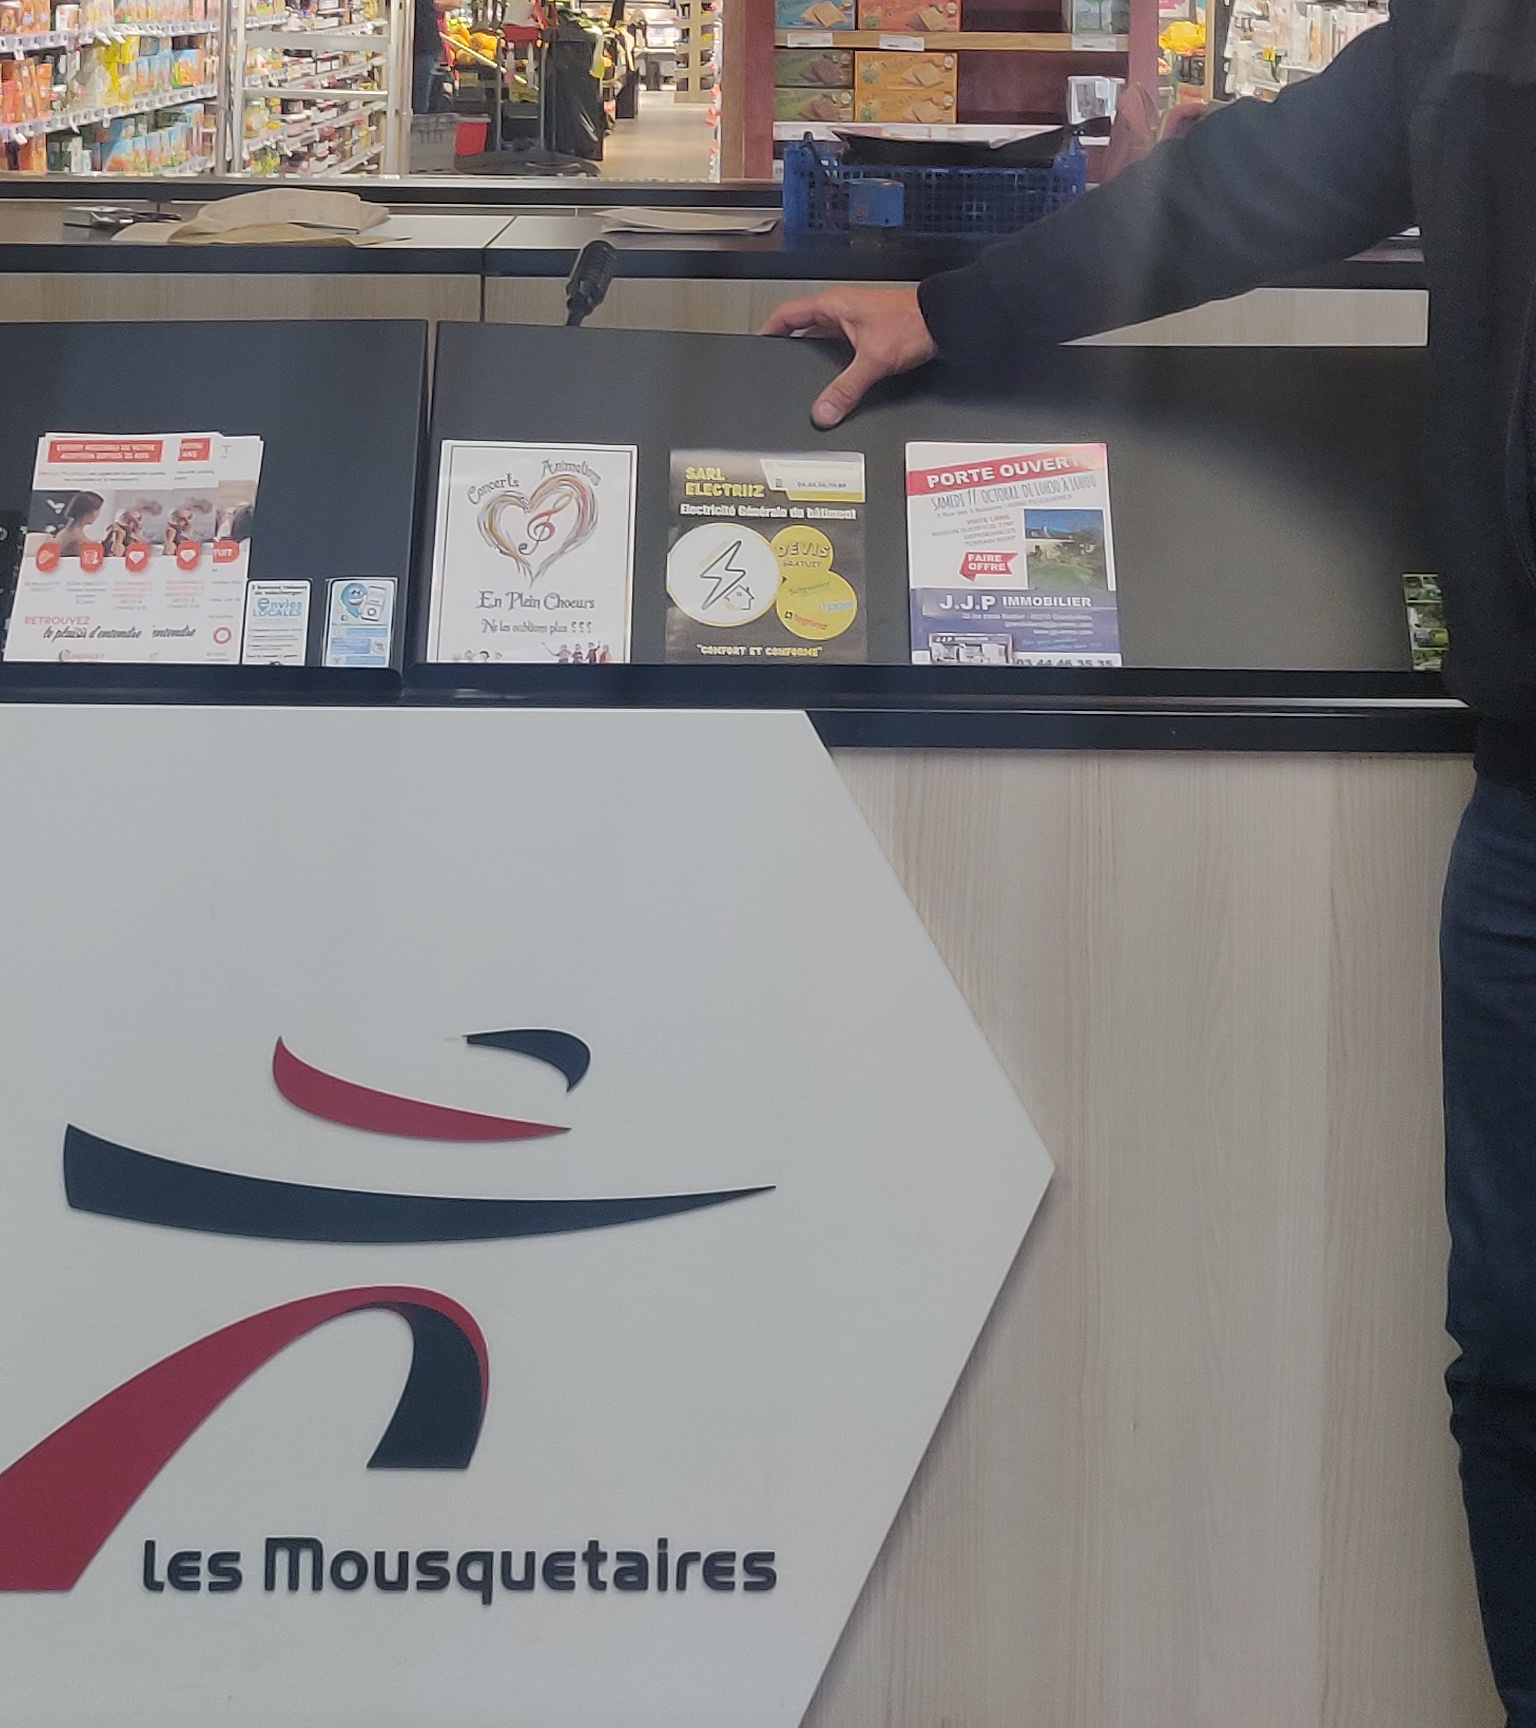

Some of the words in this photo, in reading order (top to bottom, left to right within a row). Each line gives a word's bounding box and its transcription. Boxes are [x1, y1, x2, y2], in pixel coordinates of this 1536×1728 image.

[684, 466, 725, 481] SARL
[926, 467, 996, 489] PORTE
[999, 456, 1083, 477] OUVER
[931, 492, 965, 511] SAMEDI
[981, 484, 1018, 503] OCTOBRE
[776, 541, 830, 557] DEVIS
[967, 554, 1003, 562] FAIRE
[968, 562, 1007, 572] OFFRE
[475, 590, 502, 609] En
[505, 591, 540, 610] Plein
[939, 595, 996, 610] J.J.P
[1002, 596, 1092, 608] IMMOBILIER
[141, 1538, 244, 1594] les
[262, 1534, 779, 1606] Mousquetaires
